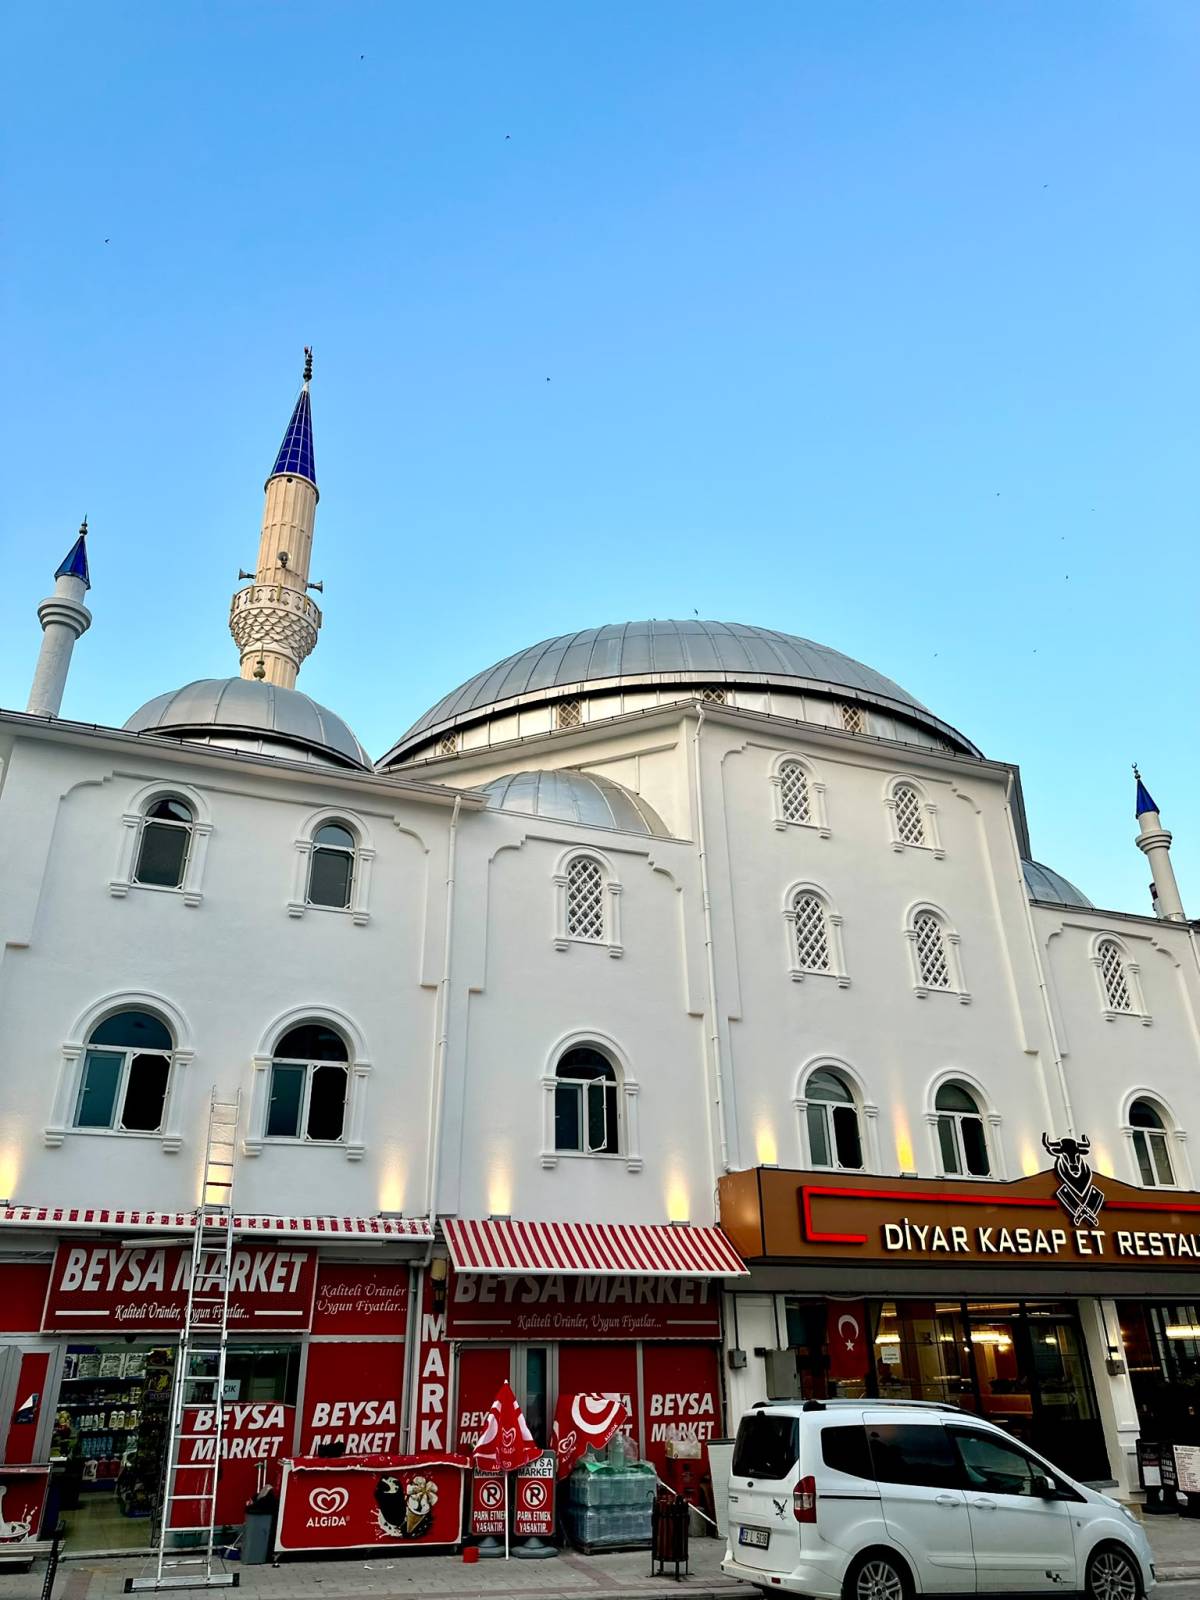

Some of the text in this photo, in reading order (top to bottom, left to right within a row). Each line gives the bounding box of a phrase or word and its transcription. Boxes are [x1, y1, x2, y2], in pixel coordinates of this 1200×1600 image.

[884, 1217, 970, 1251] DİYAR
[978, 1226, 1067, 1253] KASAP
[1075, 1230, 1106, 1255] ET
[59, 1249, 307, 1292] BEYSA MARKET
[321, 1283, 407, 1297] Kaliteli Ürünler
[454, 1273, 710, 1304] BEYSA MARKET
[114, 1303, 147, 1321] Kaliteli
[316, 1299, 353, 1314] Uygun
[517, 1313, 551, 1330] Kaliteli
[312, 1400, 396, 1427] BEYSA
[650, 1393, 714, 1416] BEYSA
[193, 1405, 285, 1431] BEYSA
[460, 1411, 490, 1427] BEY
[650, 1421, 715, 1442] MARKET
[190, 1436, 284, 1461] MARKET
[473, 1511, 489, 1520] PARK
[517, 1511, 551, 1520] PARK ETMEK
